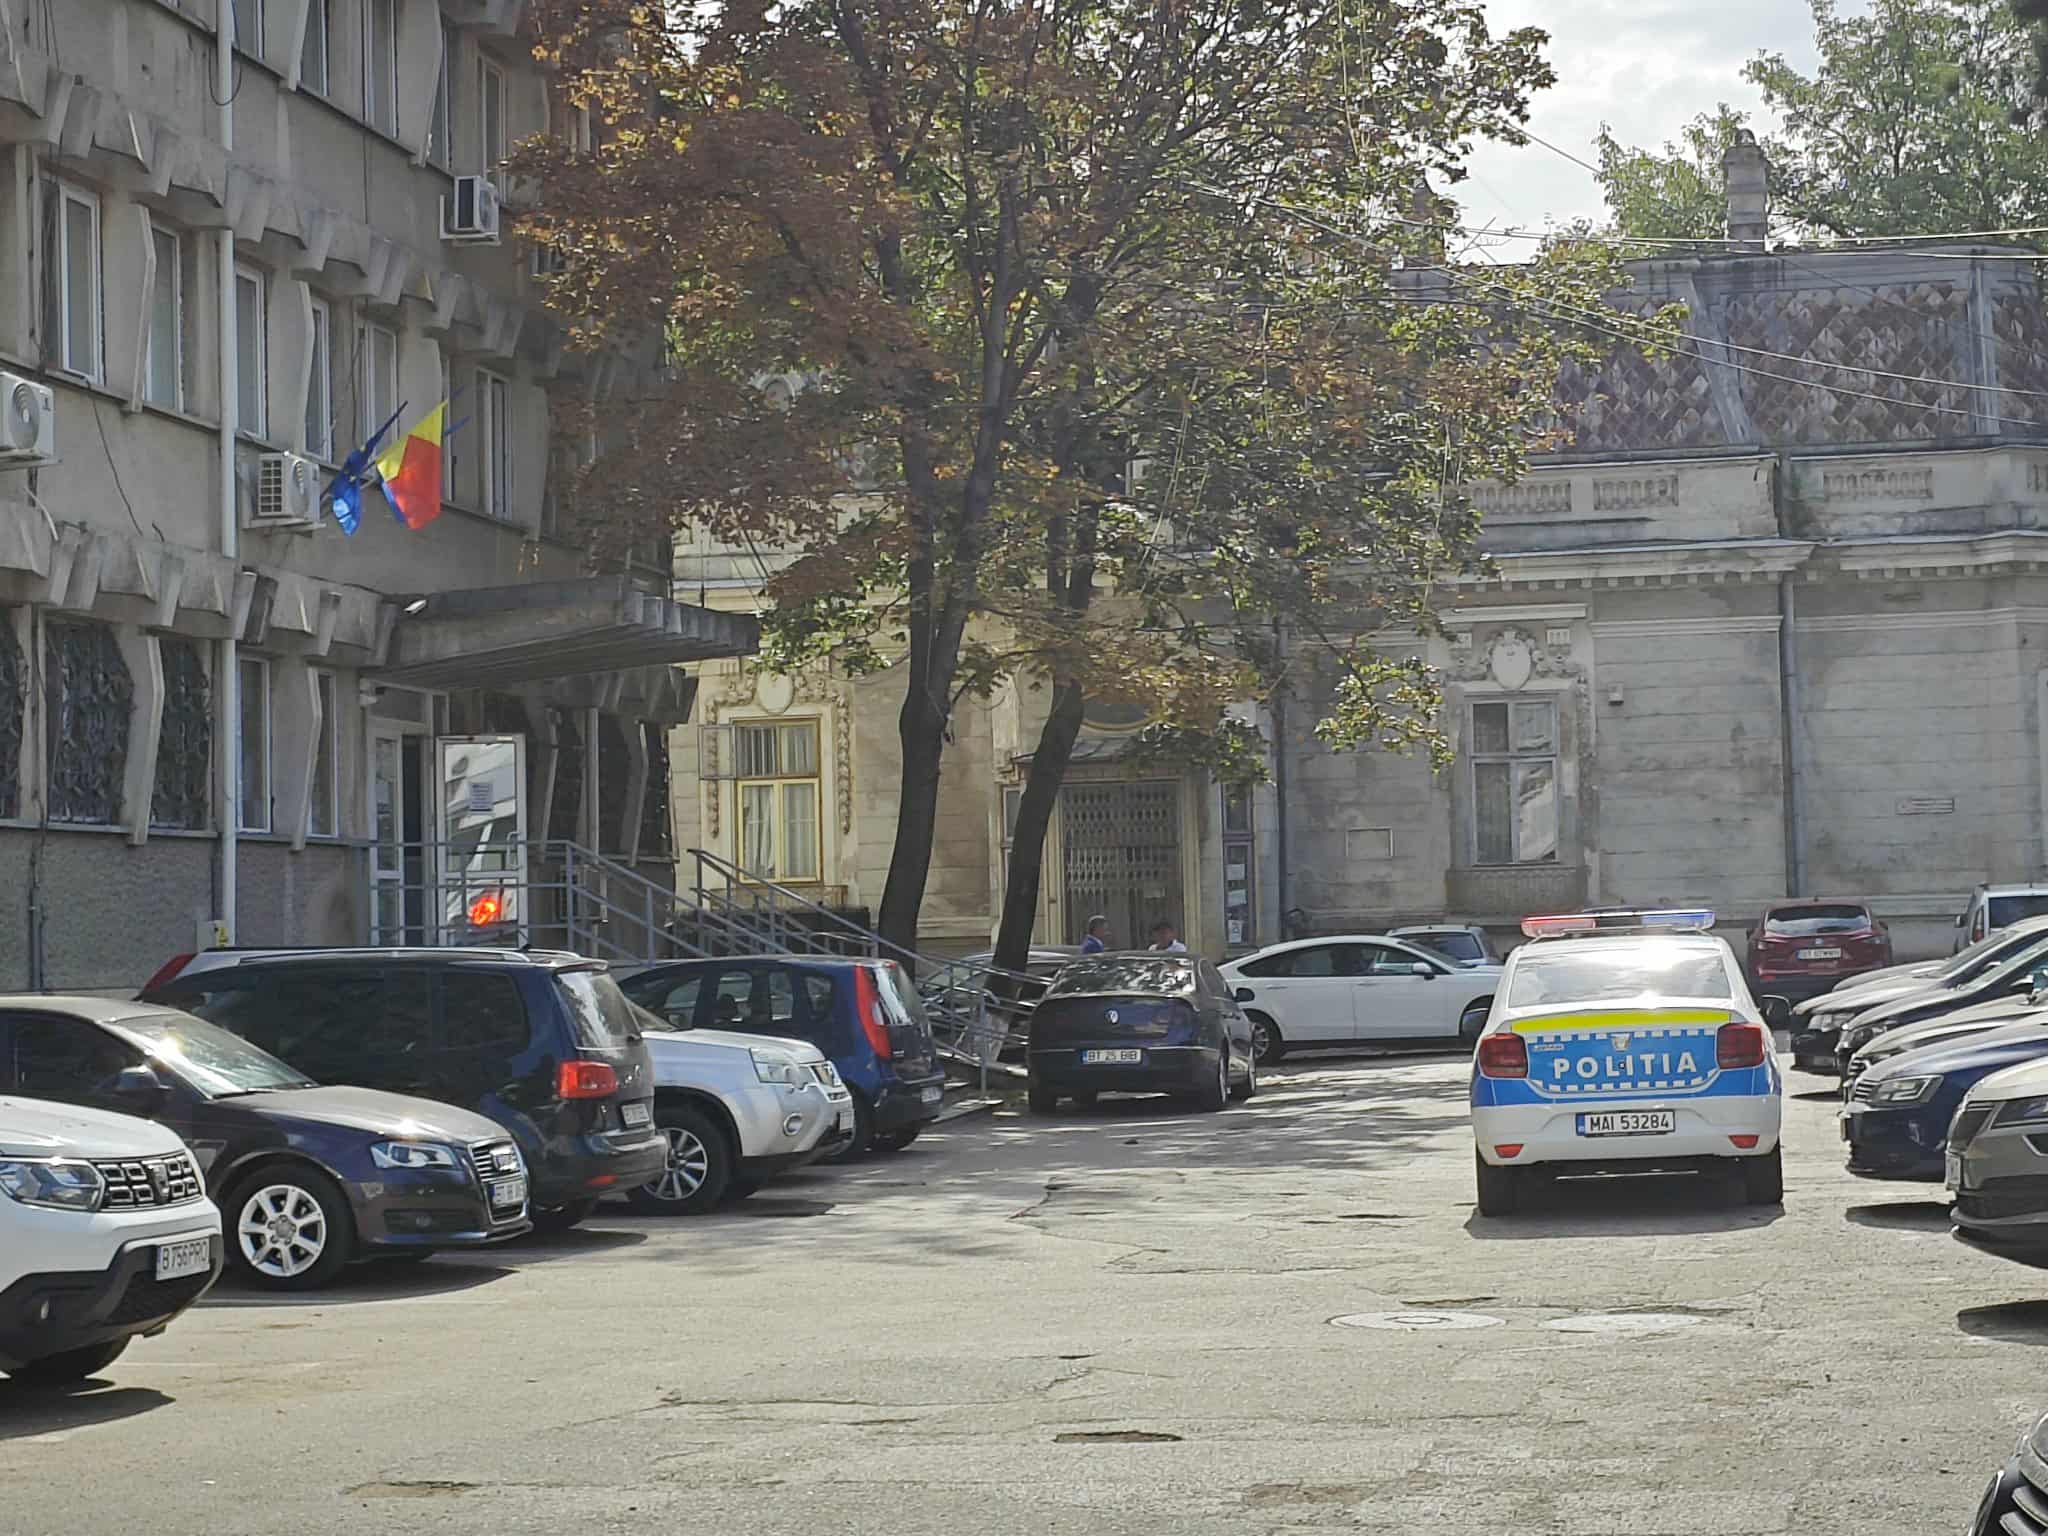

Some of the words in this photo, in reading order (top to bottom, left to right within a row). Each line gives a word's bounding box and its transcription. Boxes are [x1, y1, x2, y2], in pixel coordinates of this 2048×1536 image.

[1553, 1052, 1697, 1080] POLITIA
[1590, 1115, 1615, 1132] MAI
[1620, 1112, 1669, 1130] 53284
